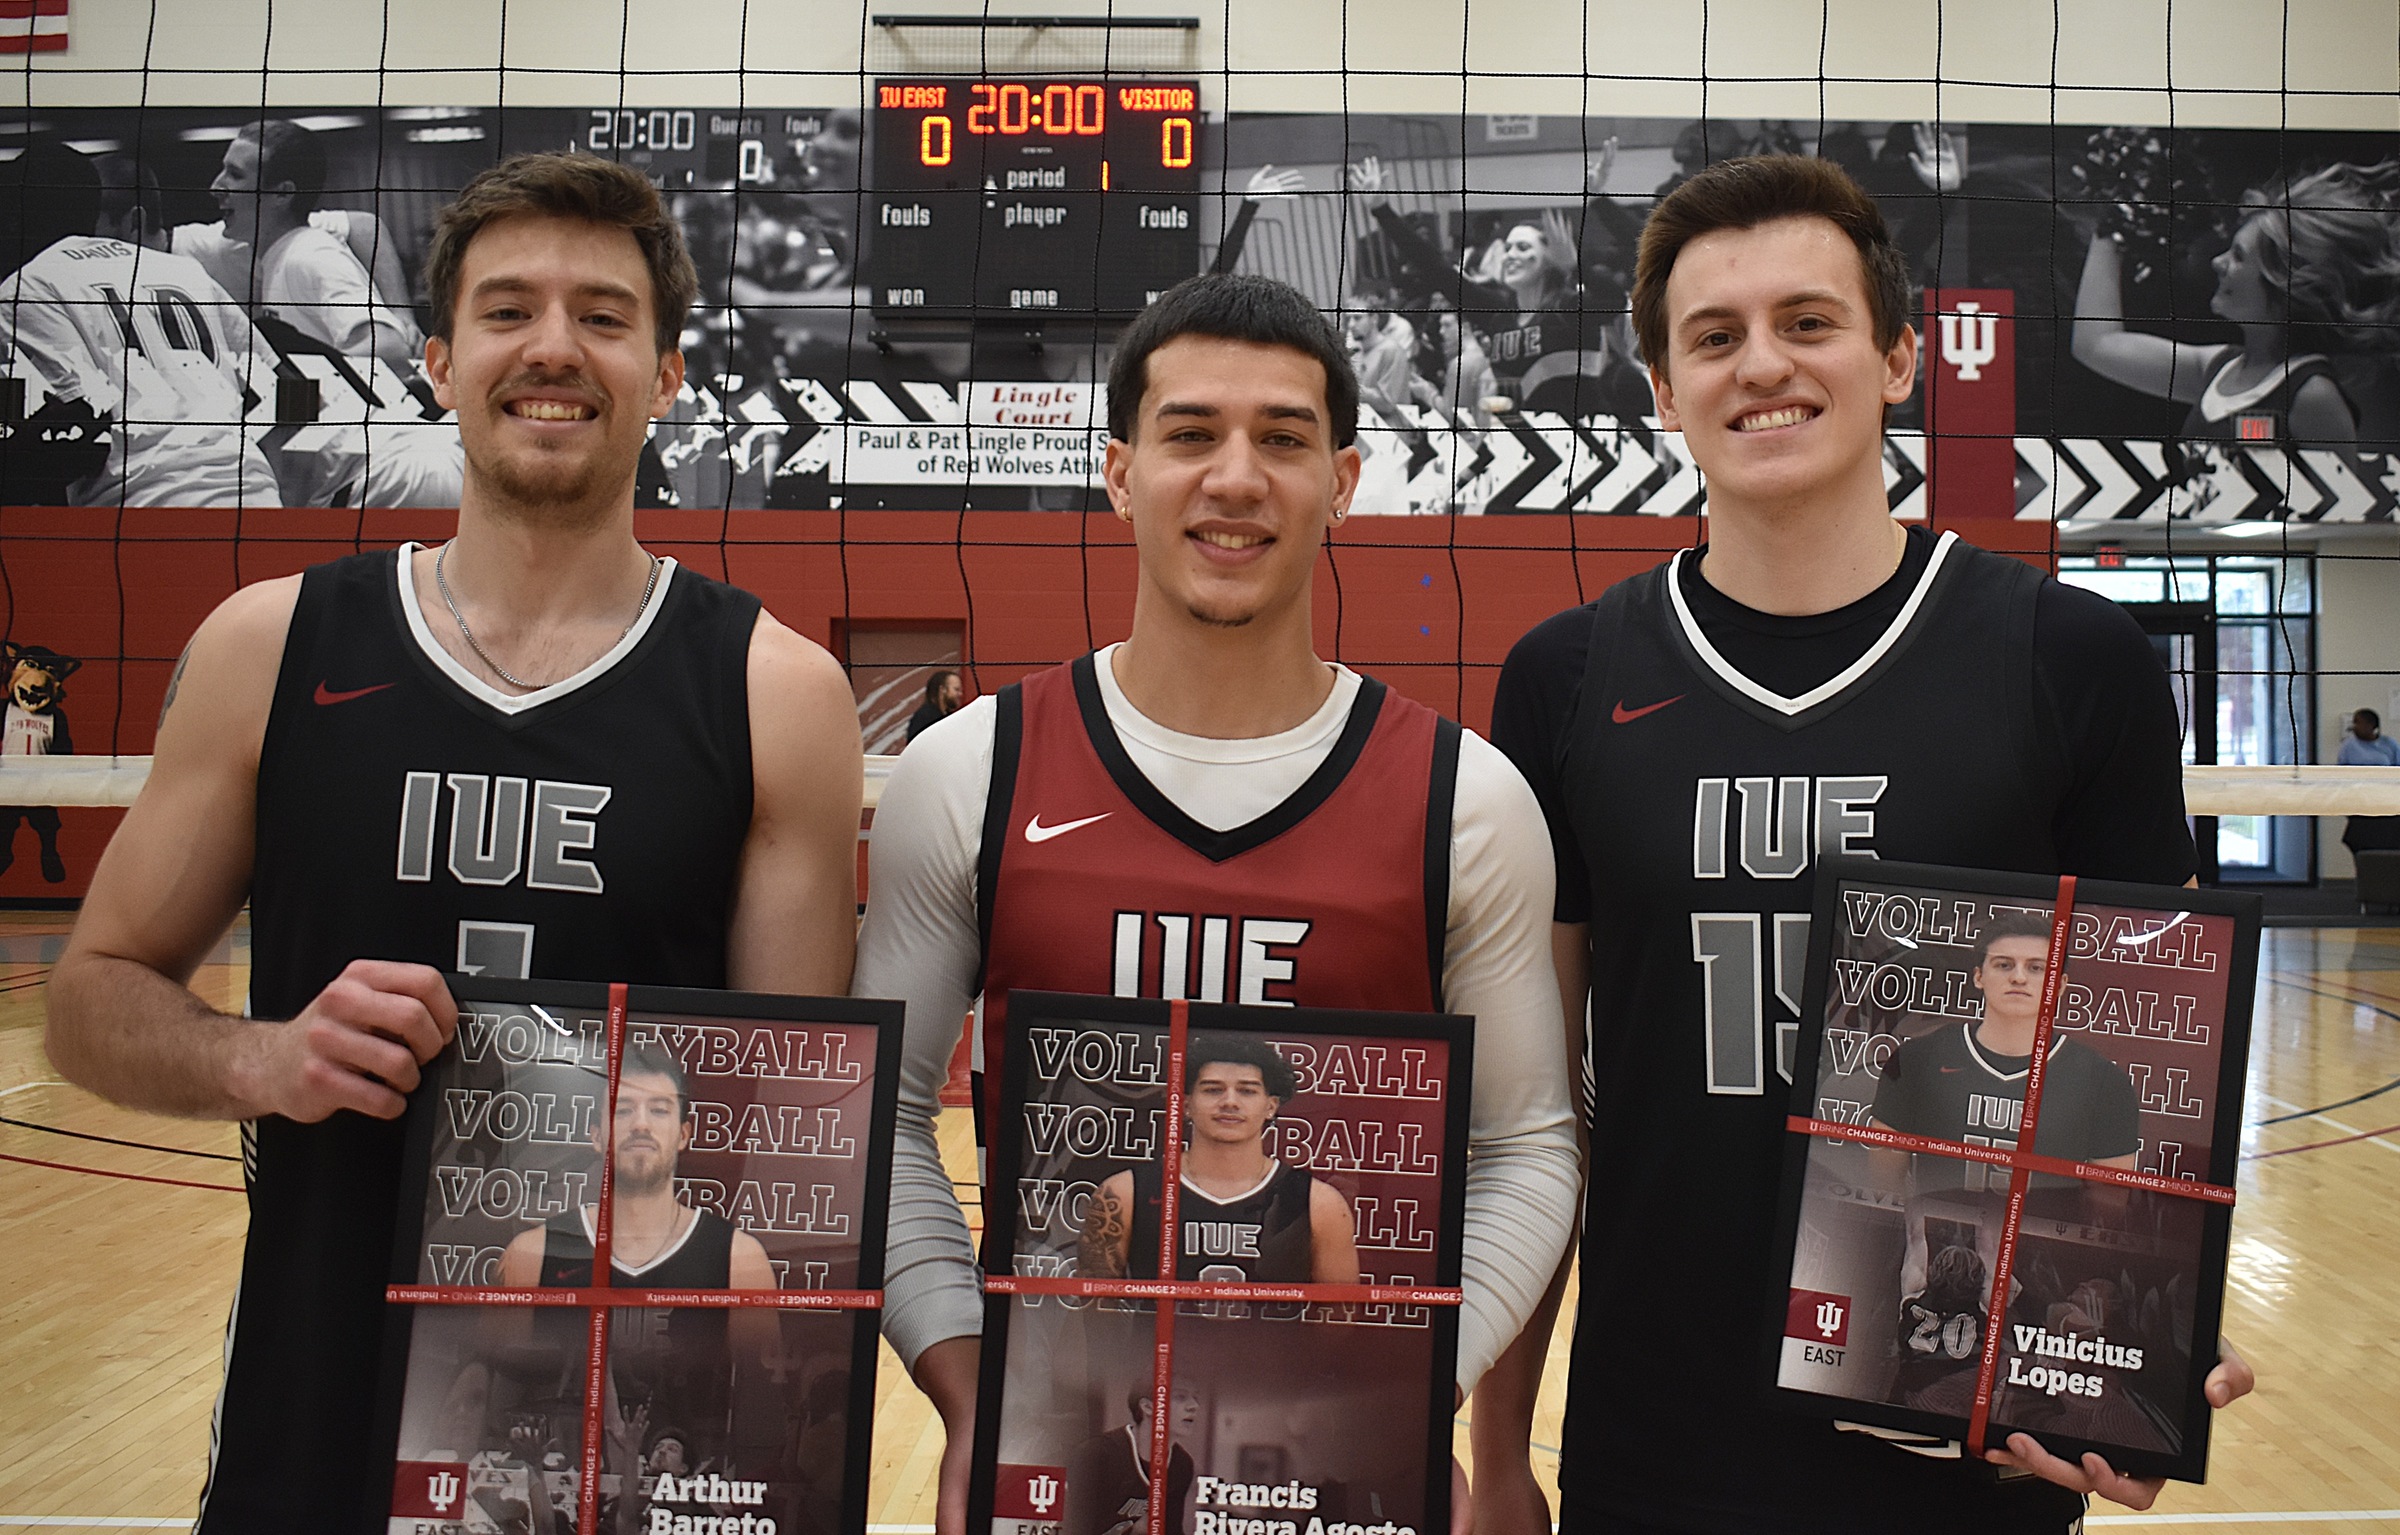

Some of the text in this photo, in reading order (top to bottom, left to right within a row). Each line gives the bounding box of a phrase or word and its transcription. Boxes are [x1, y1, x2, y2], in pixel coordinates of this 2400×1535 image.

[903, 87, 946, 108] EAST
[968, 85, 1104, 134] 20:00
[1119, 89, 1194, 111] VISITOR
[589, 110, 695, 150] 20:00
[921, 116, 951, 166] 0
[1162, 118, 1192, 168] 0
[1006, 166, 1065, 190] period
[881, 204, 931, 226] fouls
[1004, 202, 1067, 229] player
[1139, 205, 1189, 229] fouls
[62, 242, 133, 260] DAVIS
[887, 288, 925, 306] won
[1010, 288, 1058, 309] game
[90, 283, 219, 369] 10
[1491, 325, 1541, 362] IUE
[991, 387, 1077, 407] Lingle
[995, 408, 1073, 425] Court
[859, 431, 900, 449] Paul
[907, 432, 921, 449] &
[928, 432, 960, 449] Pat
[1033, 433, 1090, 451] Proud
[917, 456, 937, 473] of
[944, 456, 979, 474] Red
[986, 457, 1053, 474] Wolves
[397, 771, 612, 894] IUE
[1694, 776, 1888, 879] IUE
[1843, 890, 2217, 973] VOLLBALL
[2051, 920, 2066, 968] University
[1112, 911, 1311, 1008] IUE
[1835, 959, 2209, 1045] VOLLBALL
[2044, 970, 2057, 1005] Indiana
[445, 1089, 855, 1158] VOLLBALL
[1927, 1141, 1962, 1154] Indiana
[1165, 1183, 1175, 1220] Indiana
[2005, 1192, 2021, 1242] University
[1185, 1221, 1262, 1258] IUE
[1999, 1243, 2011, 1279] Indiana
[400, 1290, 439, 1300] Indiana
[702, 1295, 740, 1304] Indiana
[1213, 1286, 1250, 1296] Indiana
[1908, 1304, 1977, 1359] 20
[2013, 1324, 2143, 1370] Vinicius
[1804, 1345, 1846, 1367] EAST
[590, 1368, 600, 1407] Indiana
[2008, 1357, 2103, 1397] Lopes
[652, 1472, 767, 1505] Arthur
[1152, 1478, 1162, 1517] Indiana
[1195, 1476, 1317, 1510] Francis
[415, 1523, 463, 1535] EAST
[650, 1508, 777, 1535] Barreto
[1194, 1511, 1297, 1535] Rivera
